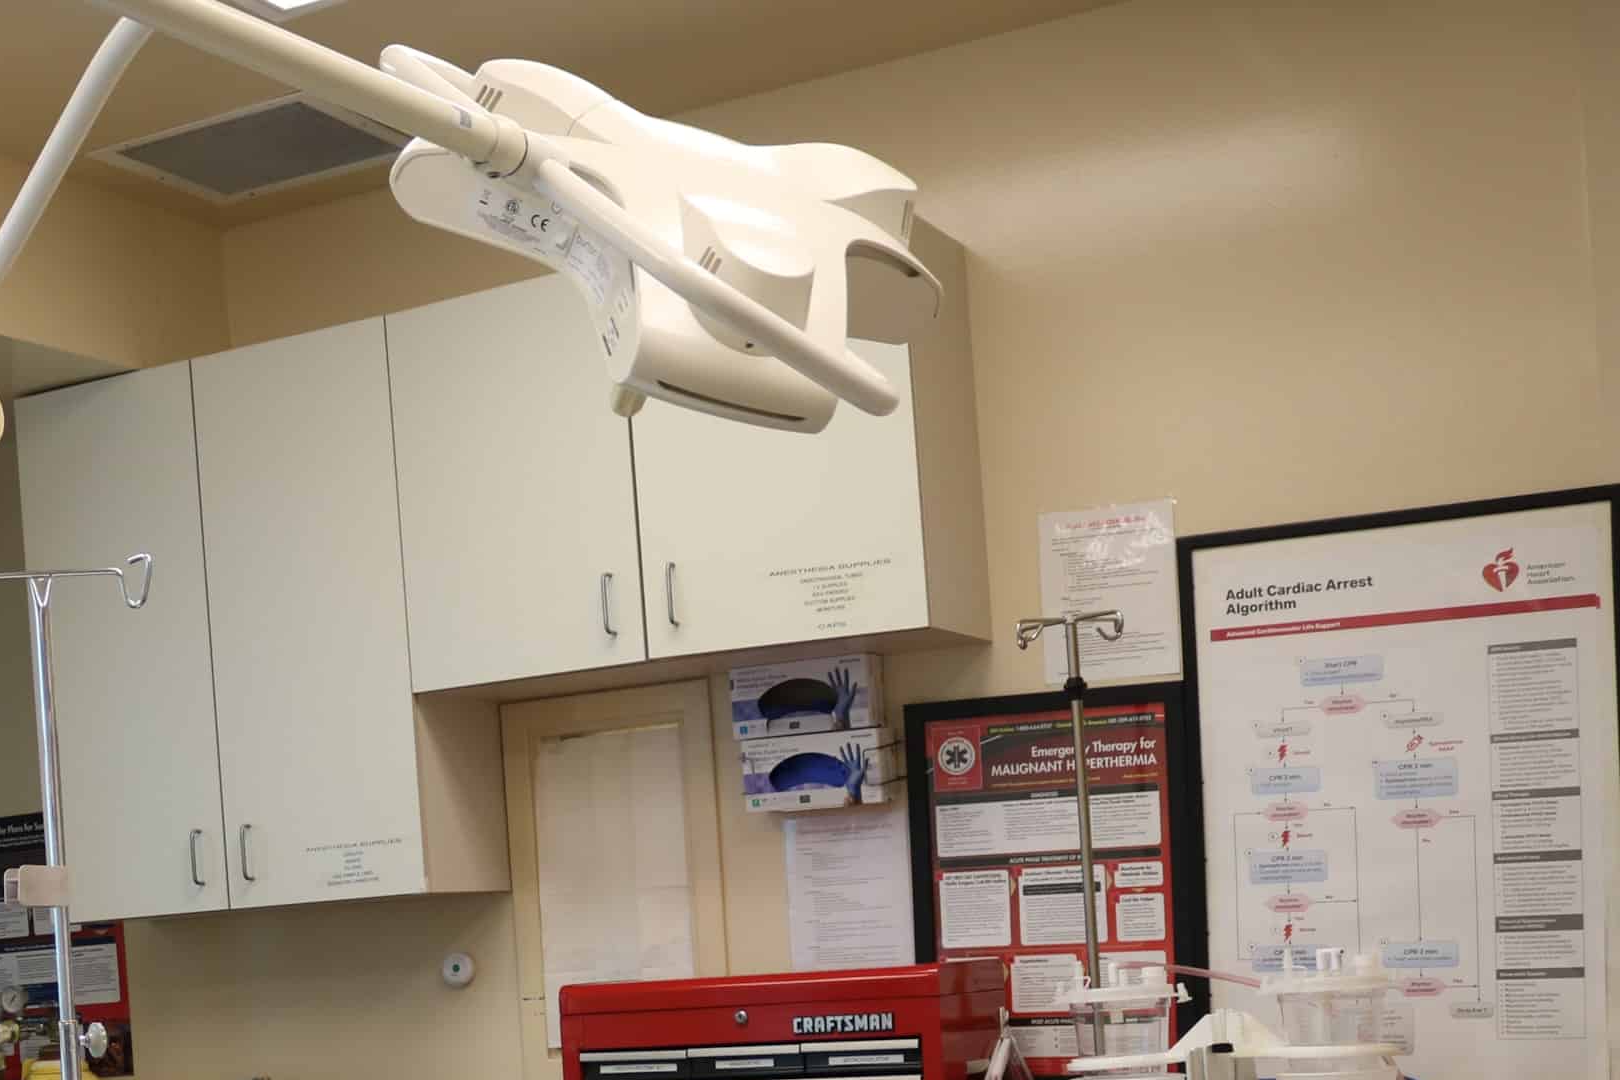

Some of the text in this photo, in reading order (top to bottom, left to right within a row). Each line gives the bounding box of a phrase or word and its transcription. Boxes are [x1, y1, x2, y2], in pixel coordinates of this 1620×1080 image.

[1226, 575, 1373, 601] Adult Cardiac Arrest
[1226, 599, 1297, 616] Algorithm
[1031, 736, 1157, 759] Emergey Therapy for
[991, 753, 1157, 777] MALIGNANT HPERTHERMIA
[792, 1013, 893, 1034] CRAFTSMAN
